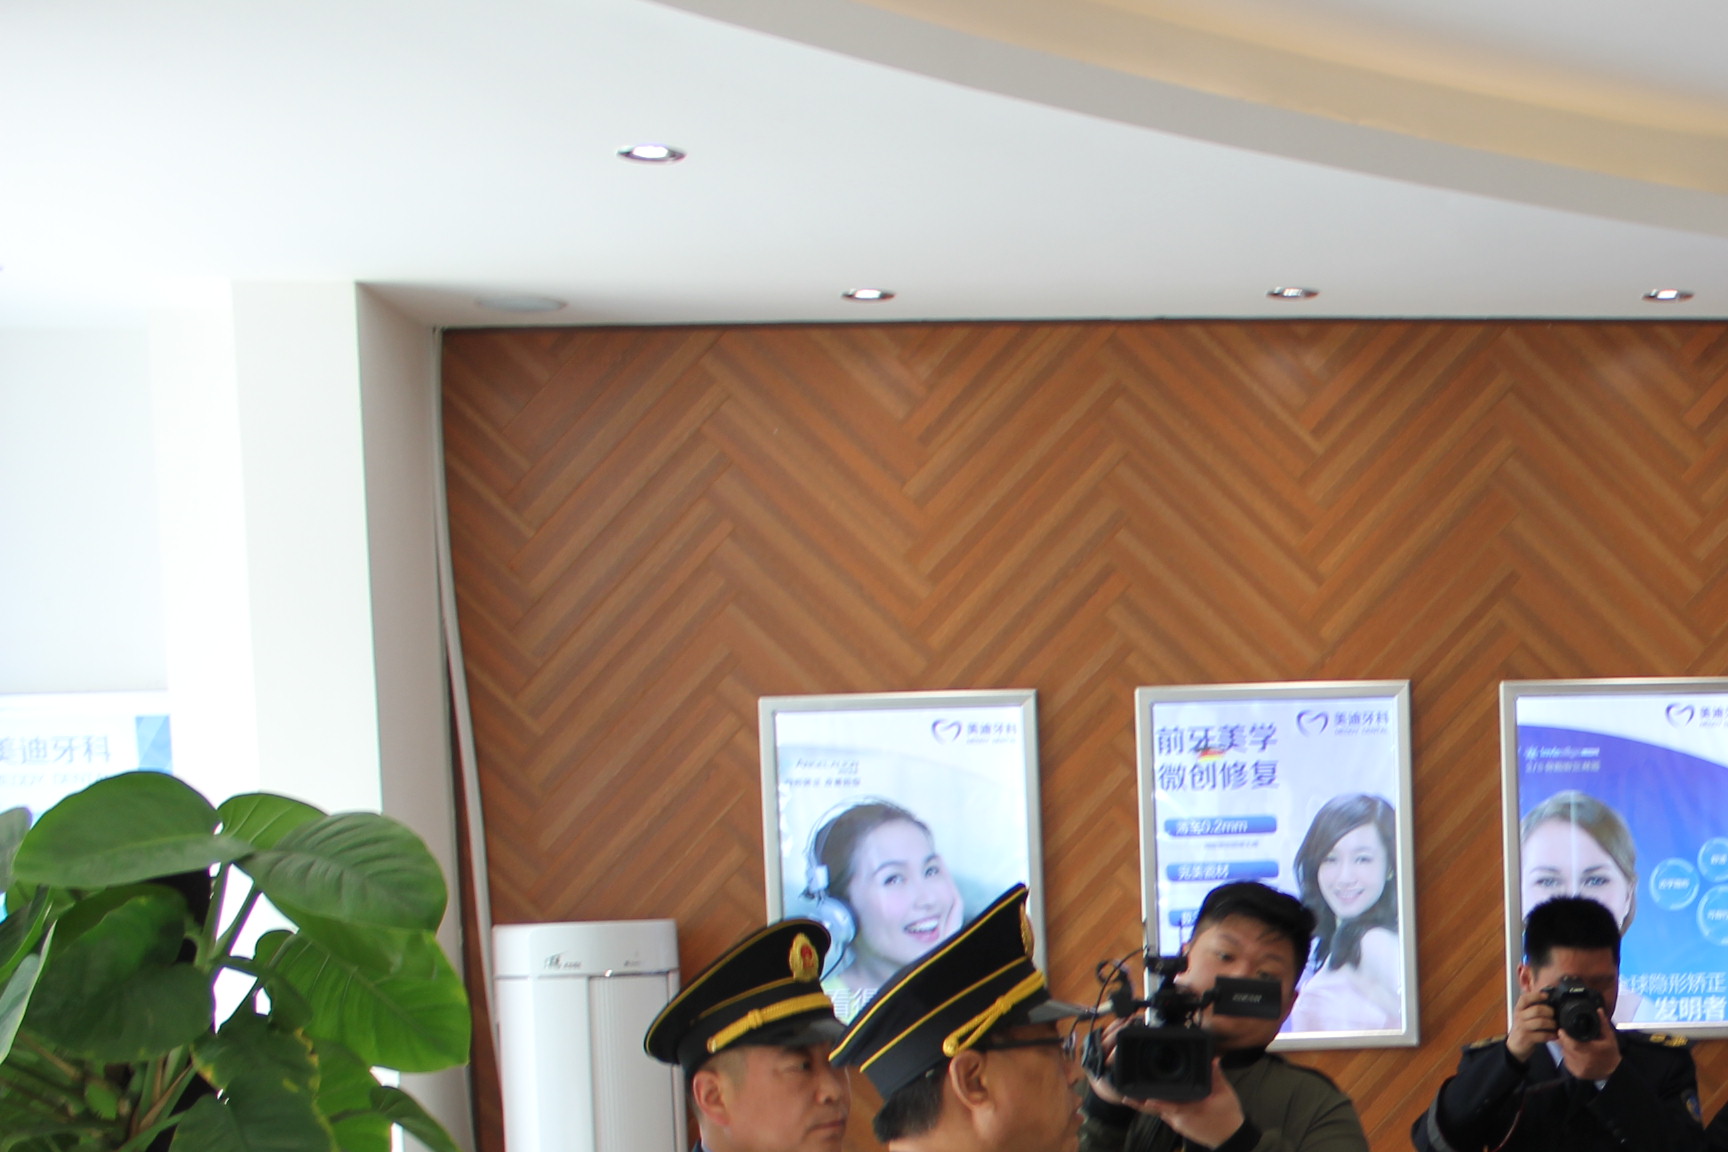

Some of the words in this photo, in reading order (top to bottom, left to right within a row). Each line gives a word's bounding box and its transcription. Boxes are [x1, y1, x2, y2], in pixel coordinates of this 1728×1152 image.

[1156, 722, 1279, 755] 前牙美学
[1158, 760, 1280, 792] 微创修复
[1655, 996, 1727, 1021] 发明者
